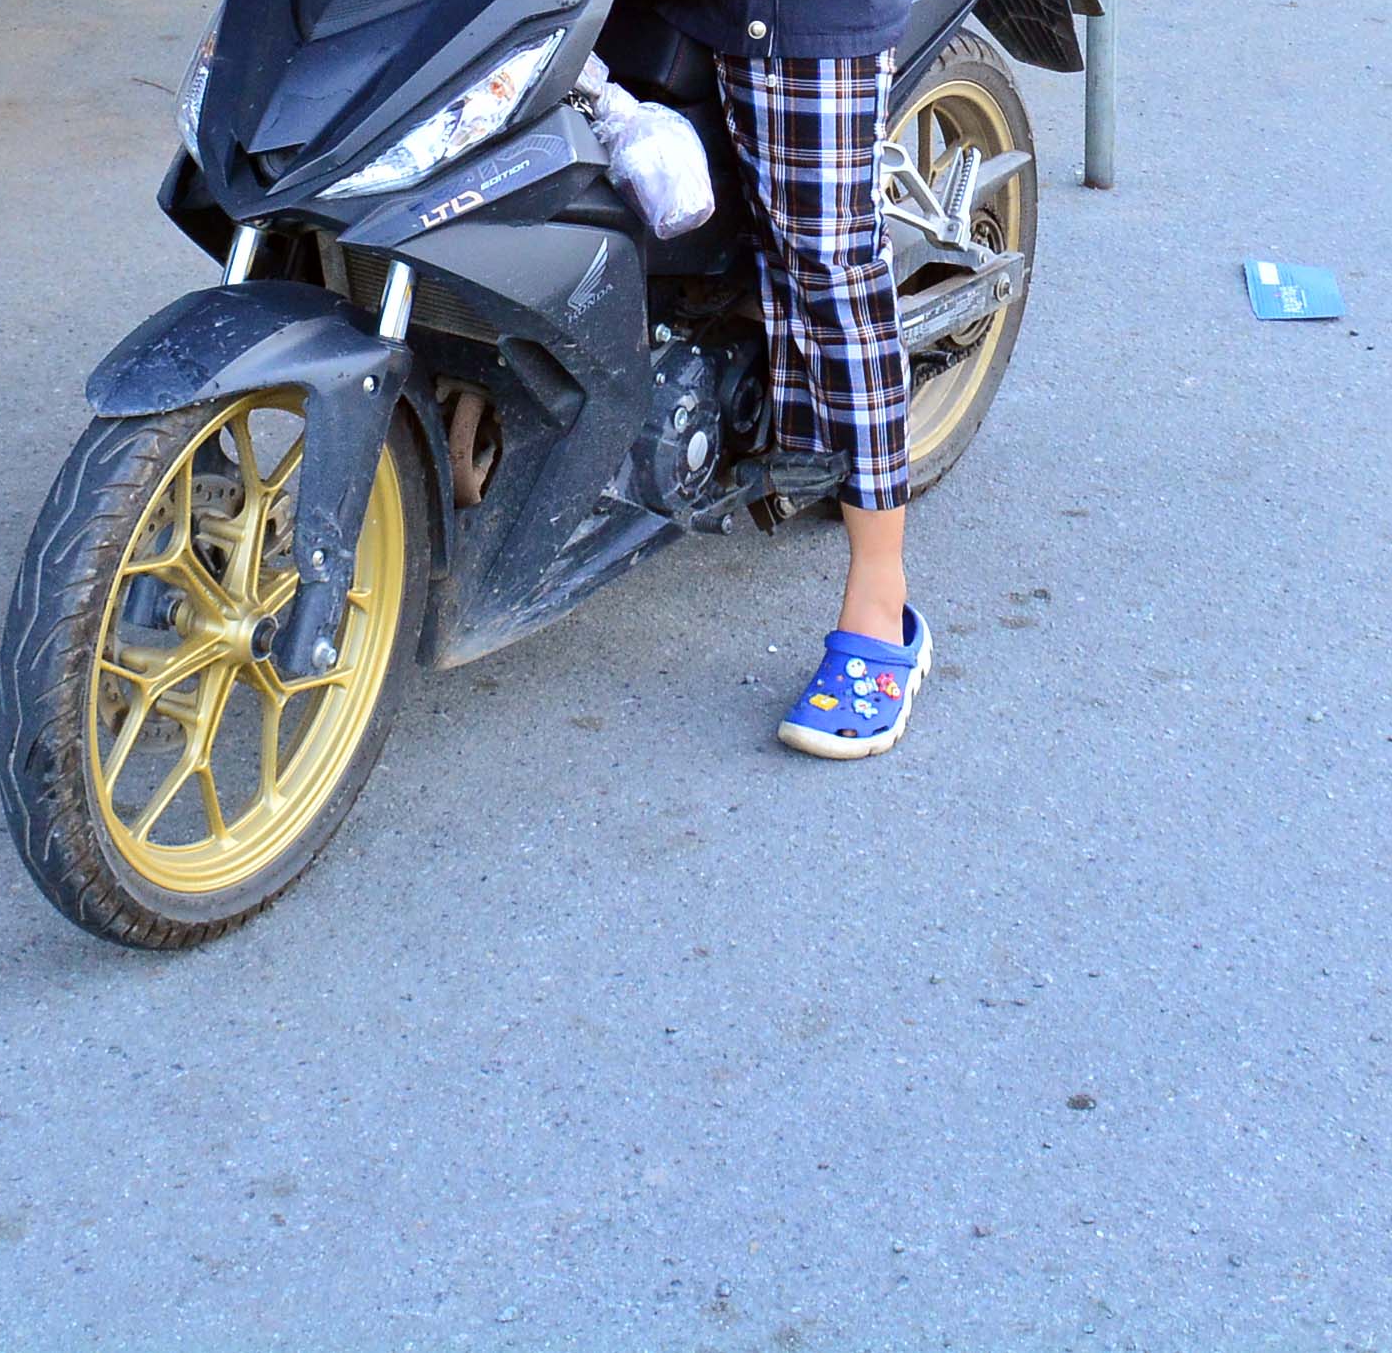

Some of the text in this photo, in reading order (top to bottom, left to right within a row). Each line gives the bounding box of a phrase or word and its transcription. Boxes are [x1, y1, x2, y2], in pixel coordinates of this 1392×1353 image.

[419, 159, 530, 229] LTD EDITION
[564, 283, 614, 323] HONDA
